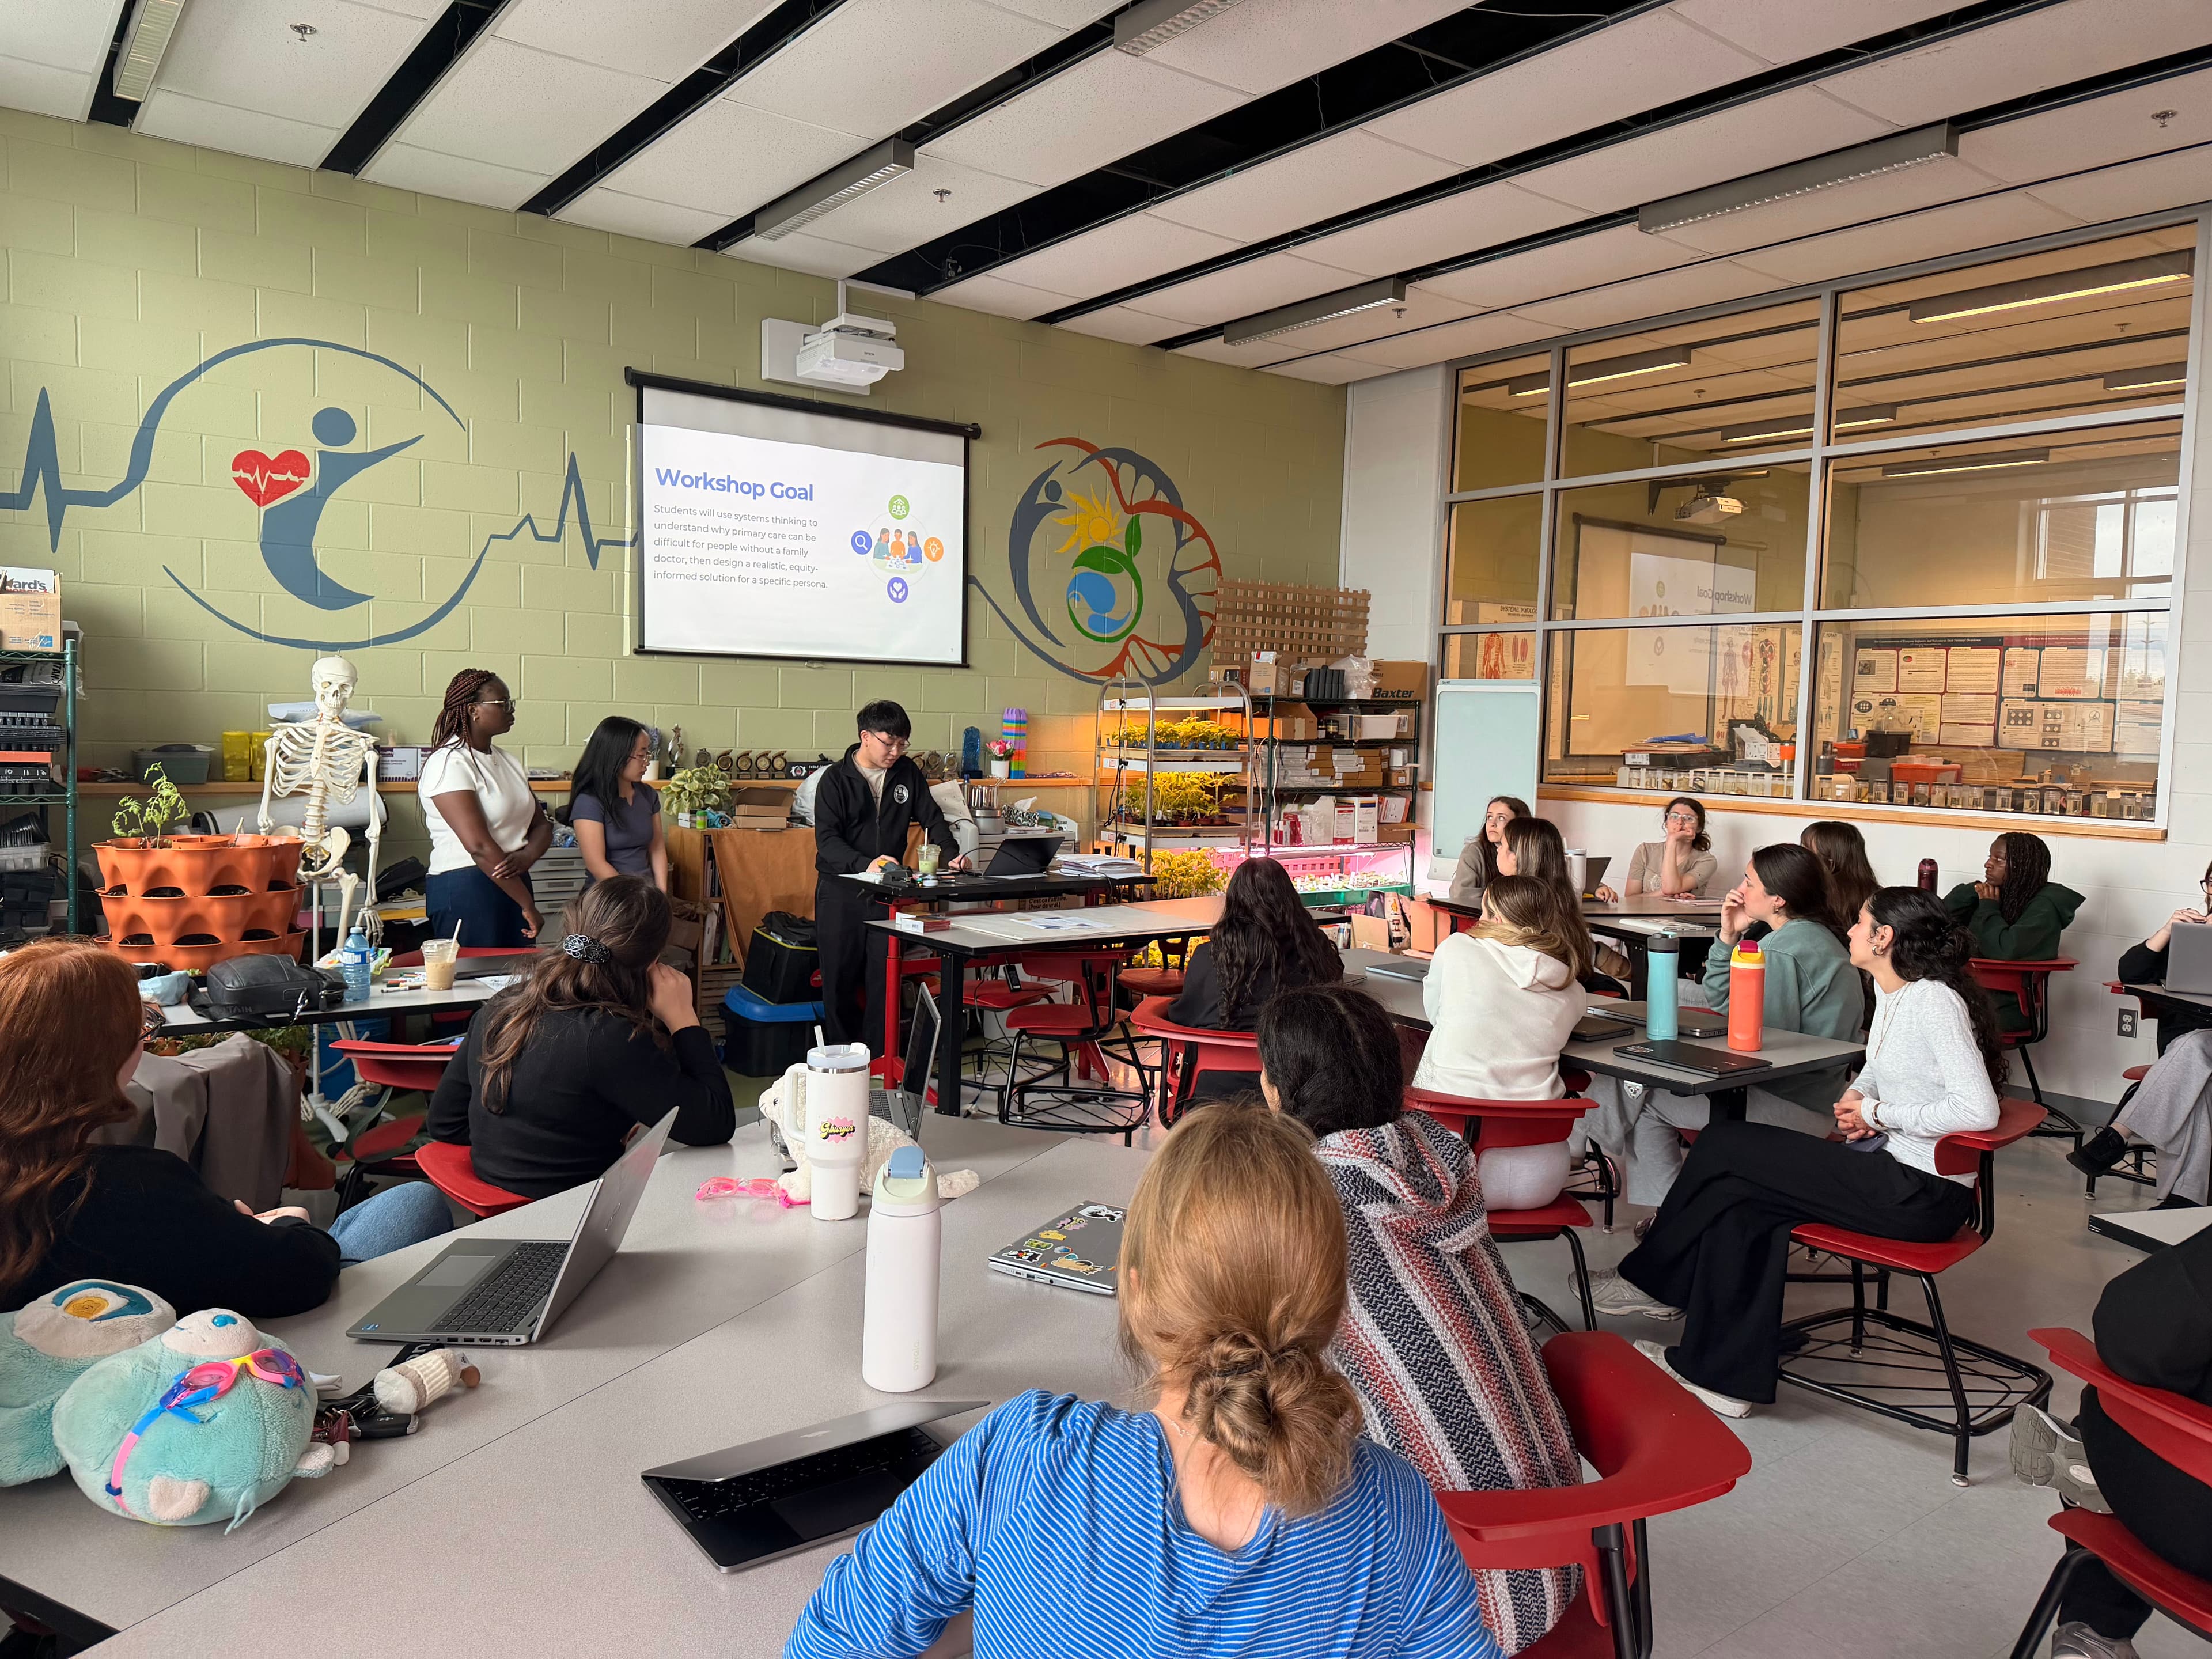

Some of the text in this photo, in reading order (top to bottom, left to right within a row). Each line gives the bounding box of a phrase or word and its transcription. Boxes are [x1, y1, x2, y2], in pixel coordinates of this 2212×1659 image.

[655, 468, 813, 501] Workshop Goal
[654, 504, 818, 528] Students will use systems thinking to
[654, 521, 709, 533] understand
[711, 525, 730, 536] why
[732, 528, 766, 540] primary
[805, 533, 816, 542] be
[653, 537, 690, 548] difficult
[692, 539, 705, 548] for
[707, 542, 738, 552] people
[739, 544, 774, 554] without
[783, 547, 809, 558] family
[653, 554, 687, 565] doctor,
[690, 556, 711, 565] then
[713, 557, 743, 569] design
[753, 560, 787, 571] realistic,
[789, 563, 819, 574] equity-
[13, 580, 47, 590] ard's
[654, 570, 698, 581] informed
[699, 573, 736, 582] solution
[738, 574, 750, 584] for
[759, 577, 791, 586] specific
[793, 580, 828, 589] persona.
[1373, 687, 1415, 698] Baxter
